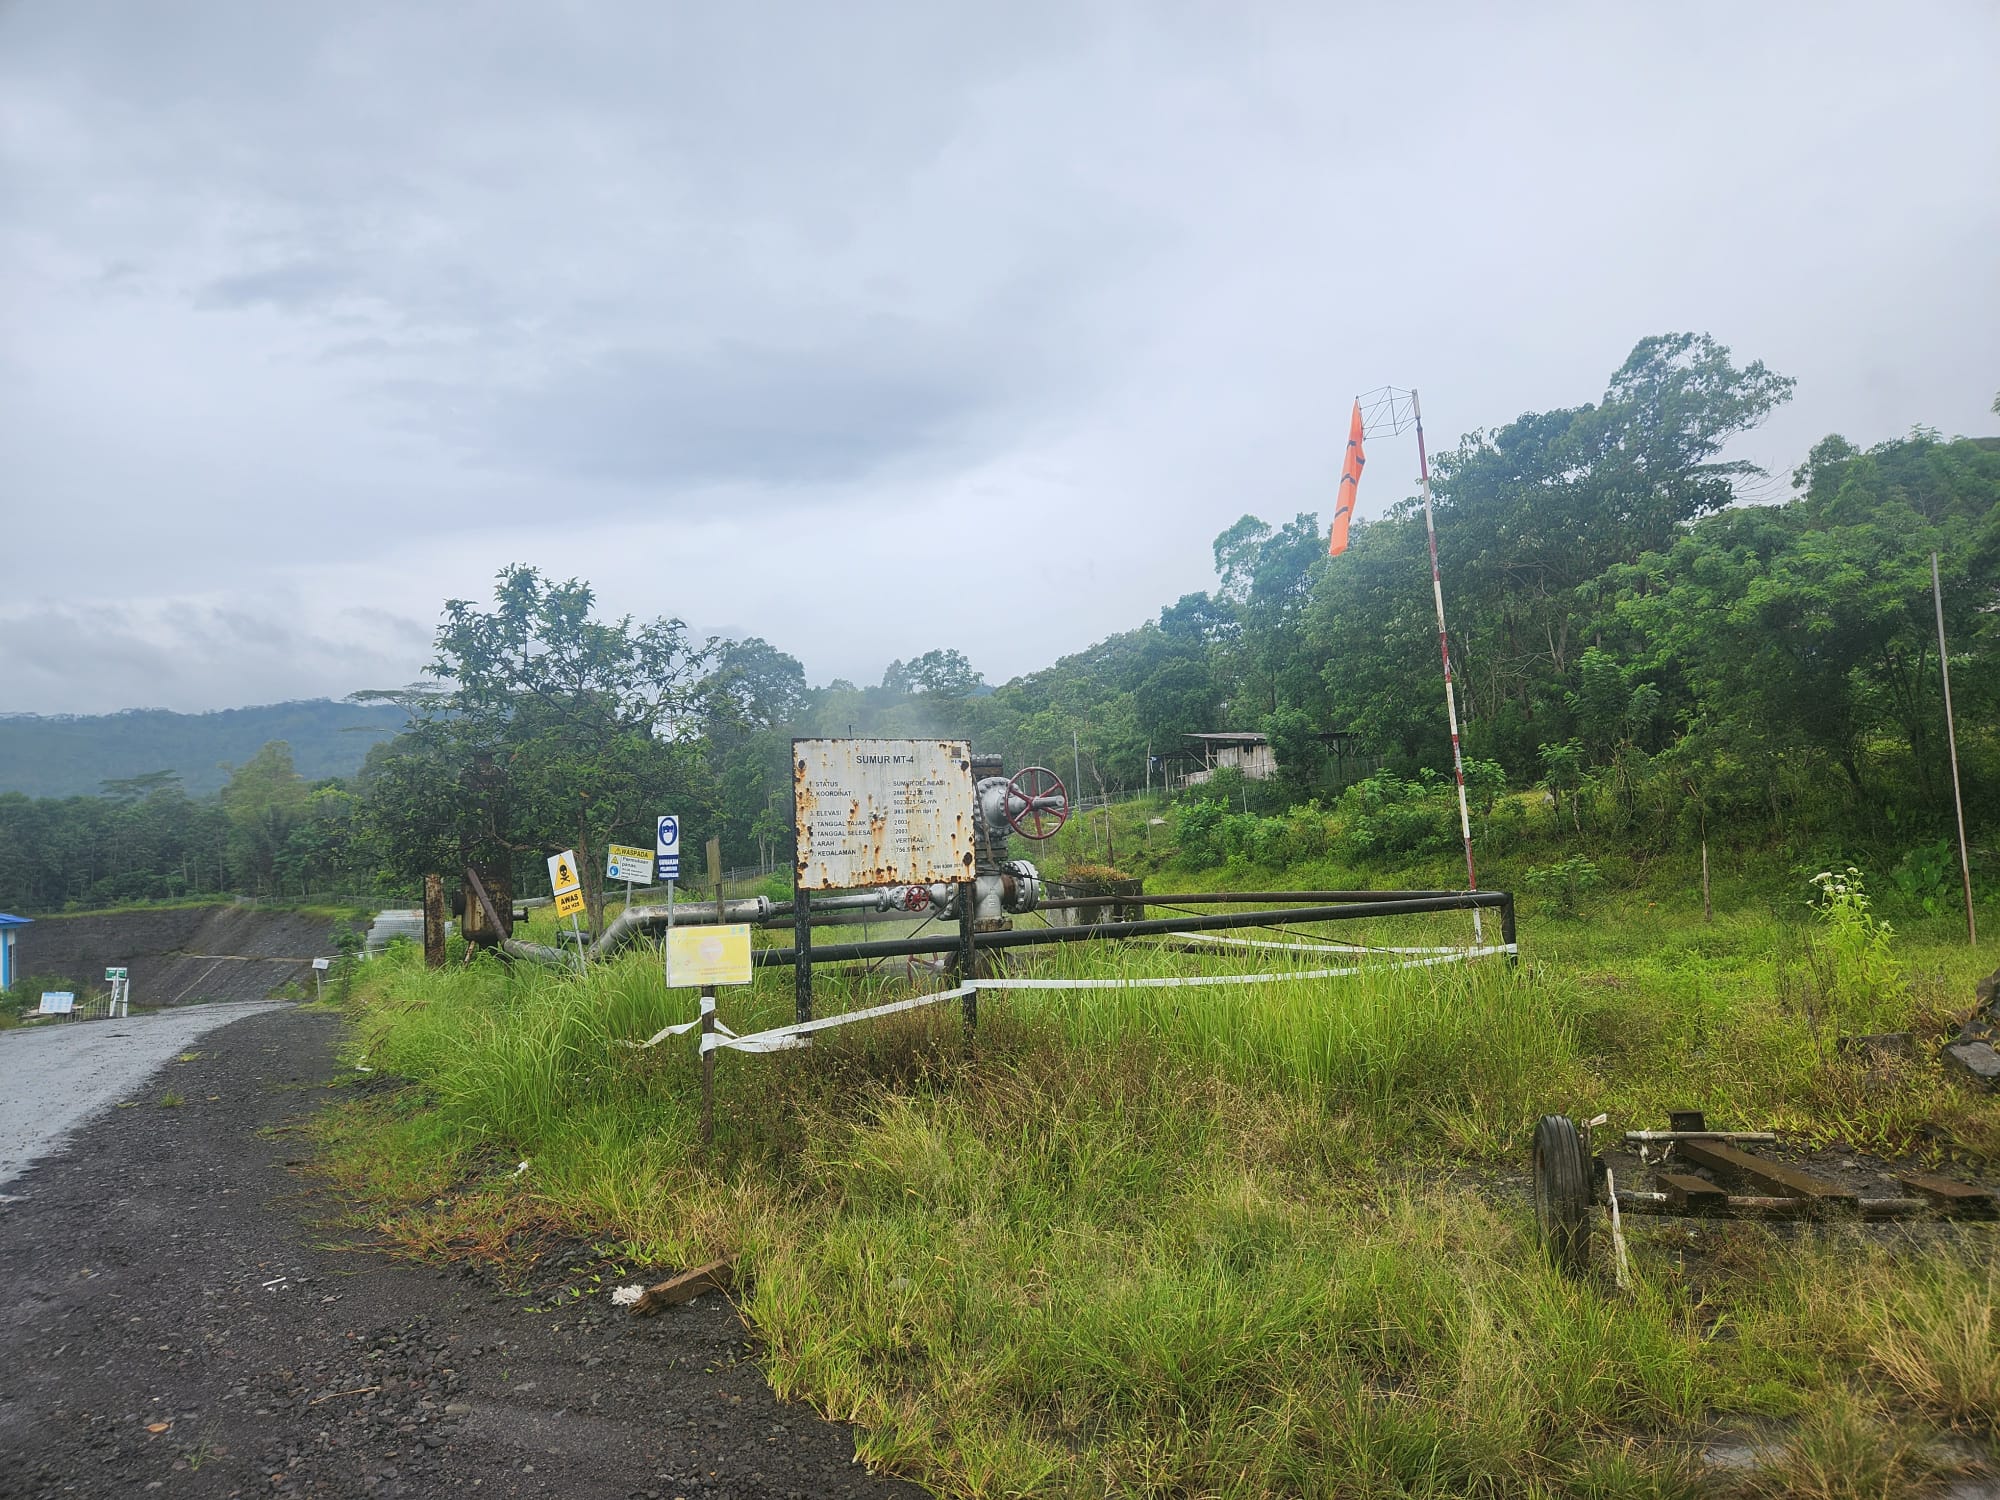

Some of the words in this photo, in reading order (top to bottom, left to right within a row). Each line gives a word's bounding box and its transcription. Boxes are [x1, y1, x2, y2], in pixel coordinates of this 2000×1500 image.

[856, 755, 890, 764] SUMUR
[893, 755, 914, 764] MT-4
[621, 849, 649, 858] WASPADA
[560, 894, 579, 905] AWAS
